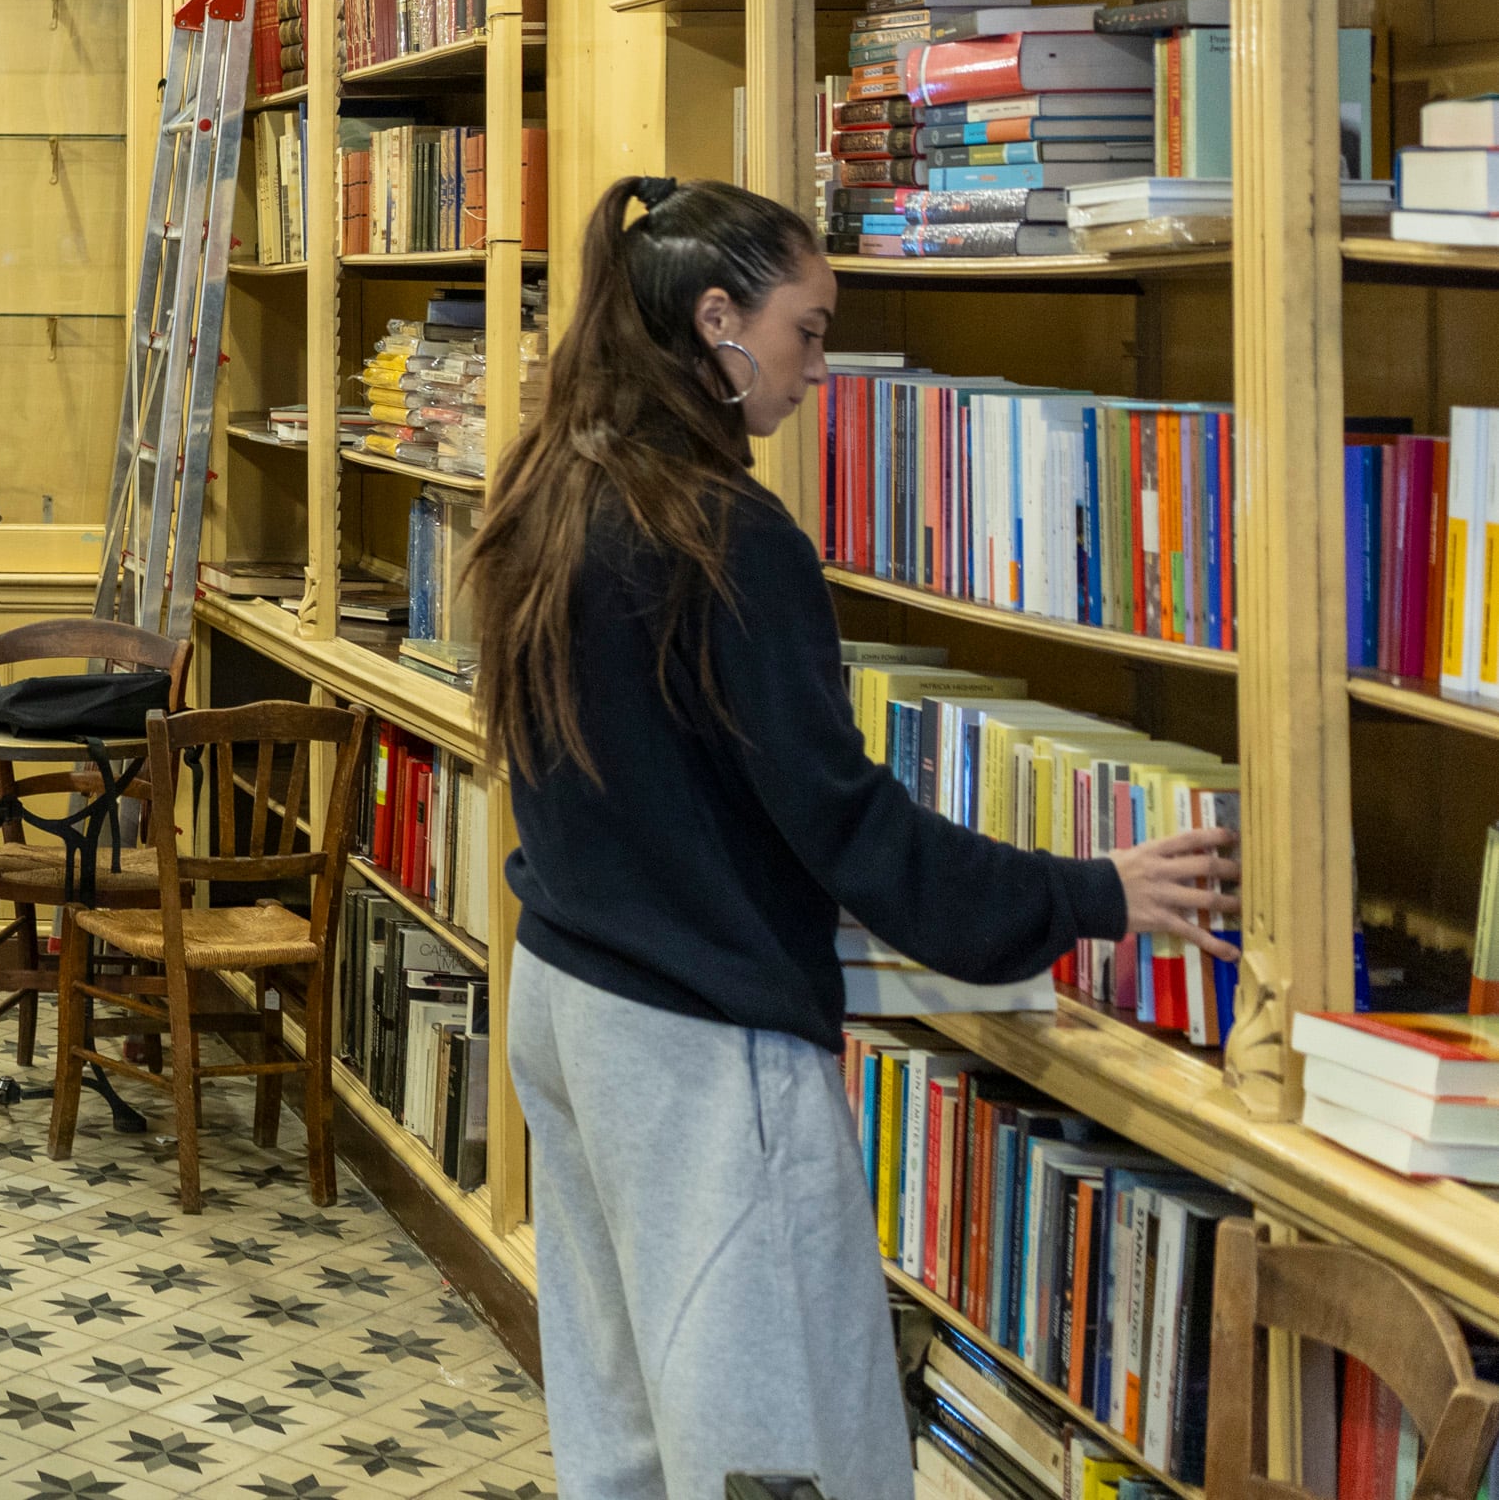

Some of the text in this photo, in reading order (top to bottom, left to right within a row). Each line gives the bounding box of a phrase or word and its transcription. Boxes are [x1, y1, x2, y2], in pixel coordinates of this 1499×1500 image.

[860, 652, 880, 663] JOHN
[919, 681, 995, 694] PATRICIA HIGHSMITH
[1131, 1207, 1147, 1293] STANLEY
